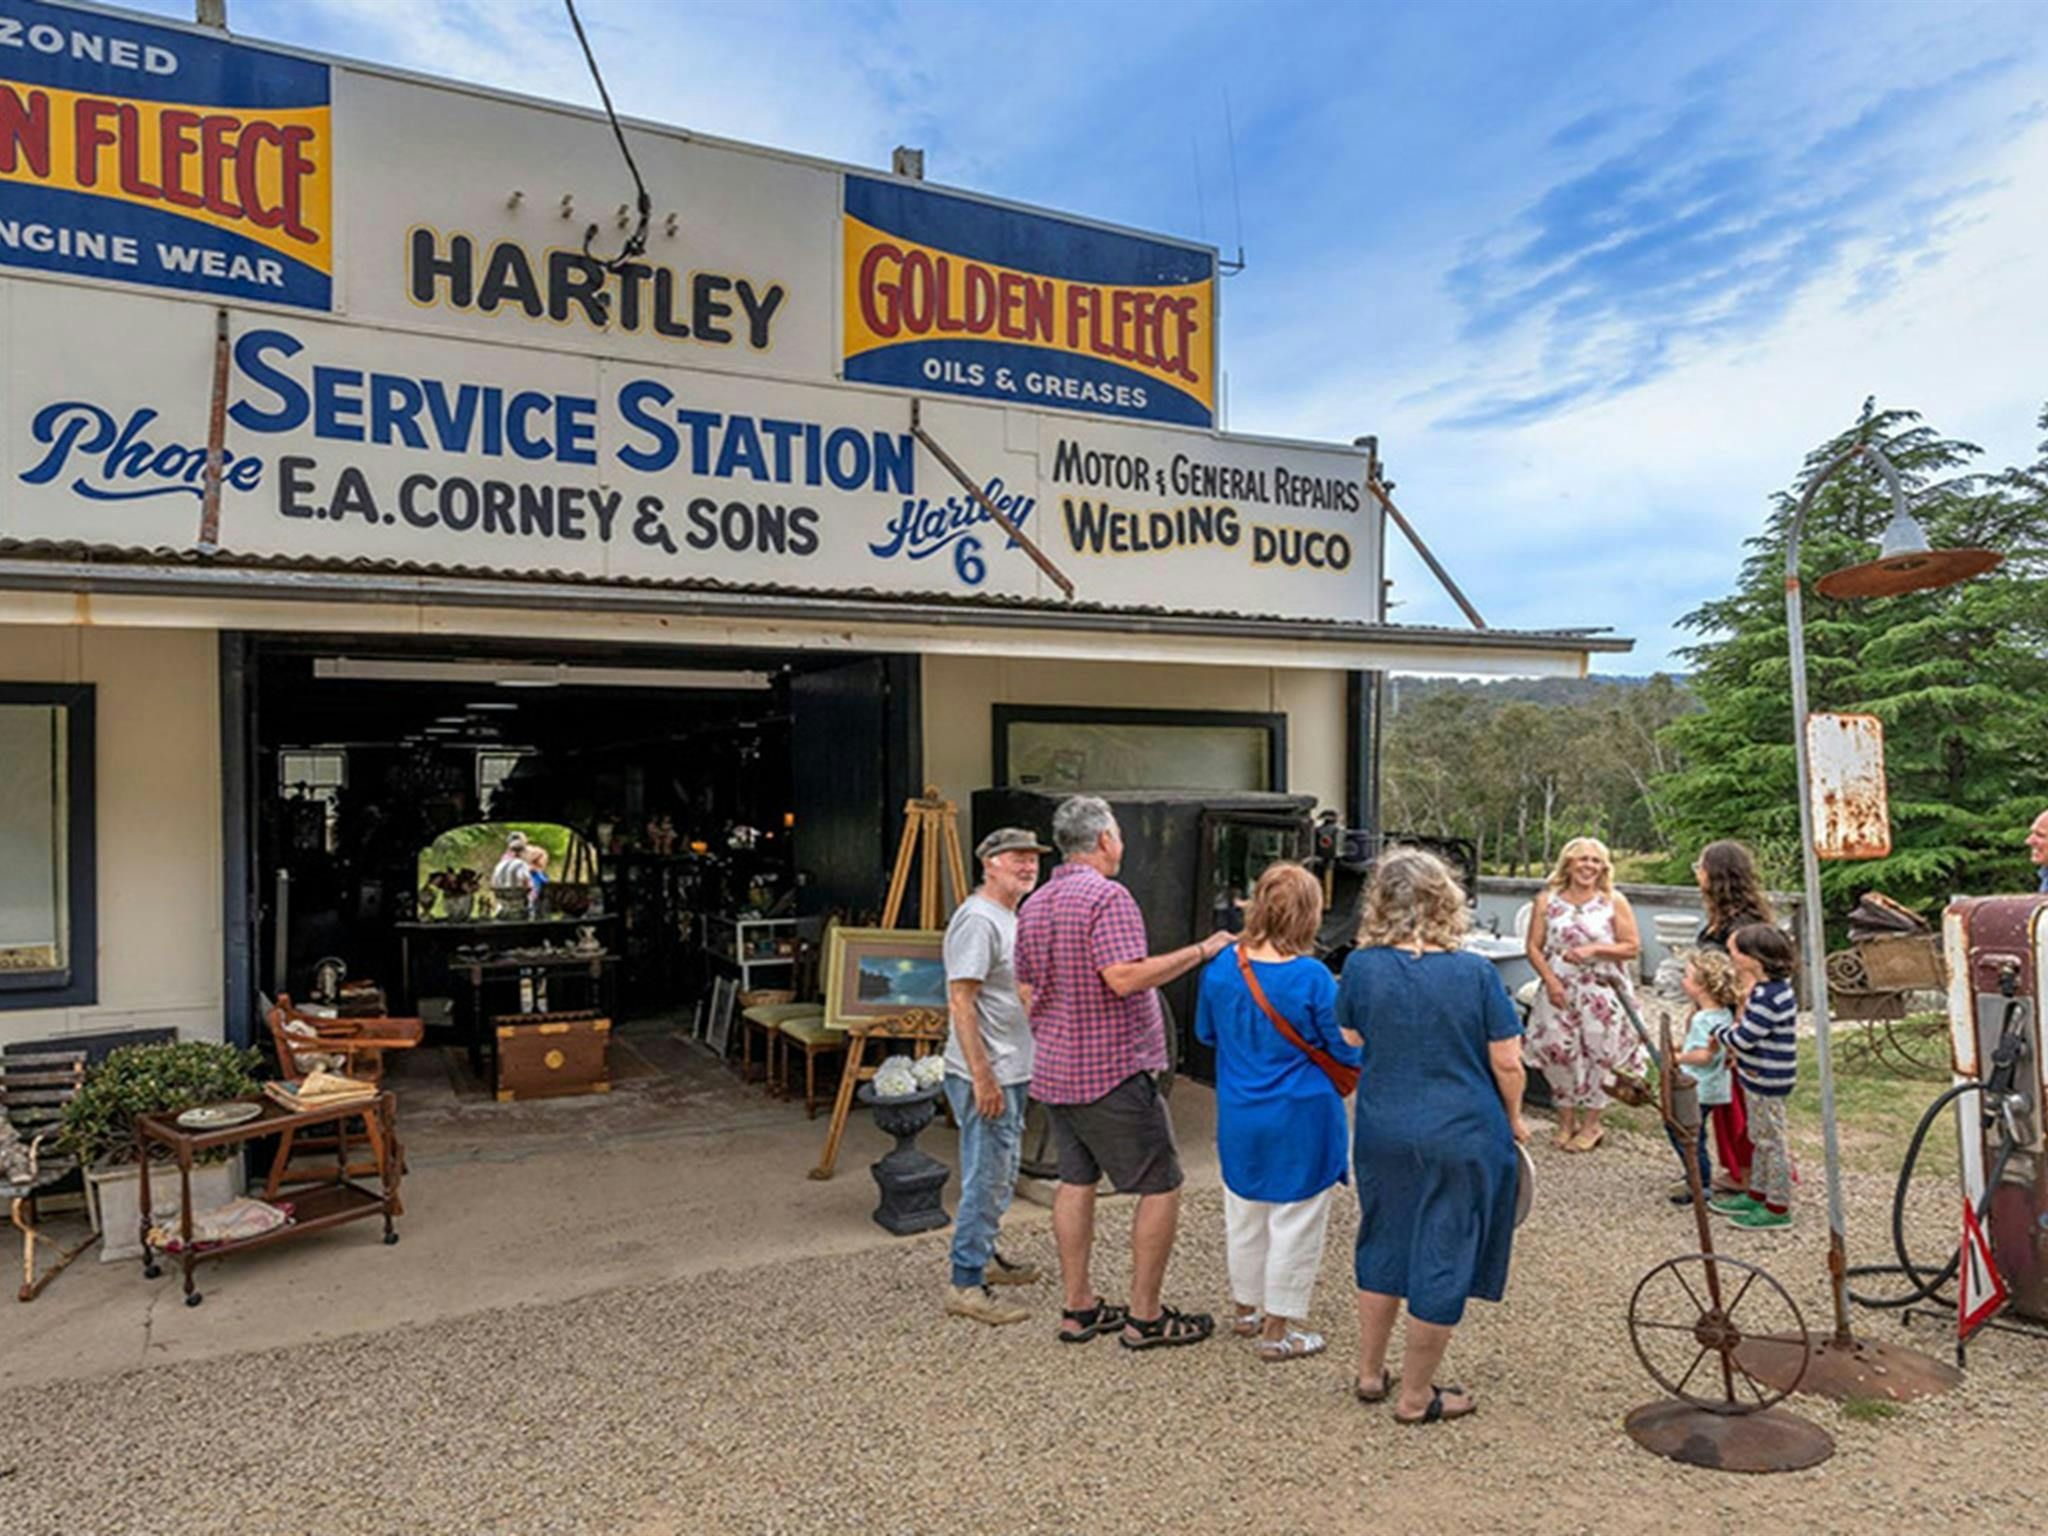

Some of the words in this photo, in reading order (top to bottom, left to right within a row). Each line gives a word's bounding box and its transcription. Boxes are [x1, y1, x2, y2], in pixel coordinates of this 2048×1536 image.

[75, 98, 318, 244] FLEECE
[157, 243, 284, 286] WEAR
[412, 229, 784, 349] HARTLEY
[859, 243, 1053, 342] GOLDEN
[1067, 285, 1198, 383] FLEECE
[228, 330, 597, 466] SERVICE
[617, 379, 914, 495] STATION
[923, 358, 985, 386] OILS
[995, 368, 1016, 393] &
[1025, 372, 1147, 408] GREASES
[1053, 440, 1149, 491] MOTOR
[1171, 454, 1270, 504] GENERAL
[1275, 466, 1360, 513] REPAIRS
[633, 496, 677, 554] &
[686, 498, 819, 556] SONS
[954, 536, 986, 585] 6
[1064, 498, 1239, 553] WELDING
[1253, 525, 1351, 570] DUCO
